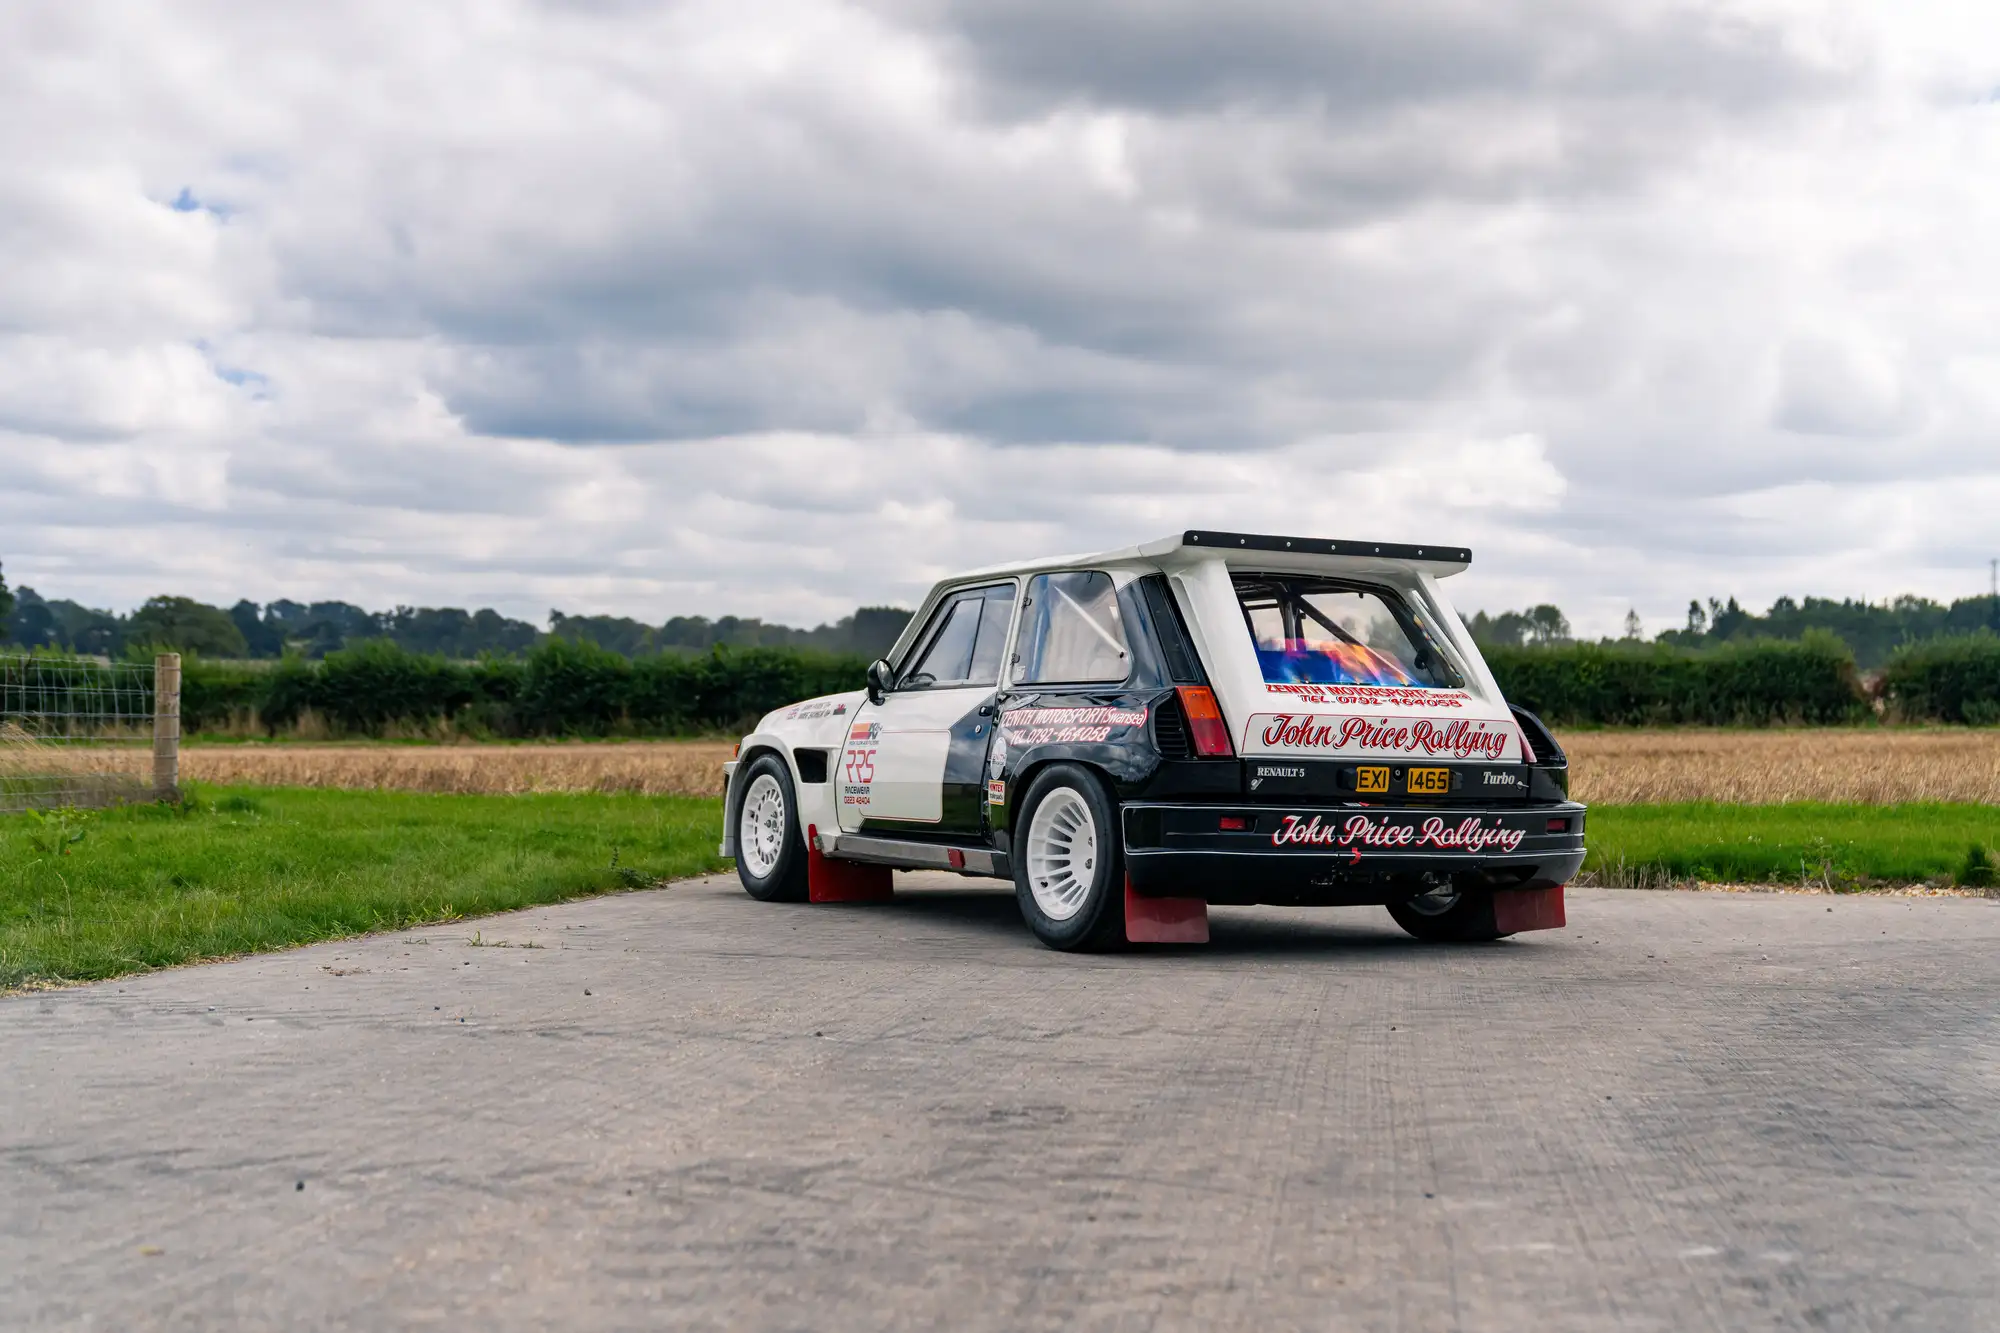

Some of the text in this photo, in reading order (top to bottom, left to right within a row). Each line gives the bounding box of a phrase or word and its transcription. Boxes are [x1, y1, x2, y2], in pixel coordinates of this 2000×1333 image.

[1265, 684, 1325, 695] ZENITH
[1001, 709, 1035, 727] ZENITH
[1263, 714, 1507, 759] John Price Rallying
[1257, 767, 1305, 778] RENAULT 5
[1483, 772, 1515, 785] Turbo
[1409, 771, 1447, 790] 1465
[845, 786, 870, 794] RACEWEAR
[1272, 815, 1526, 853] John Price Rallying
